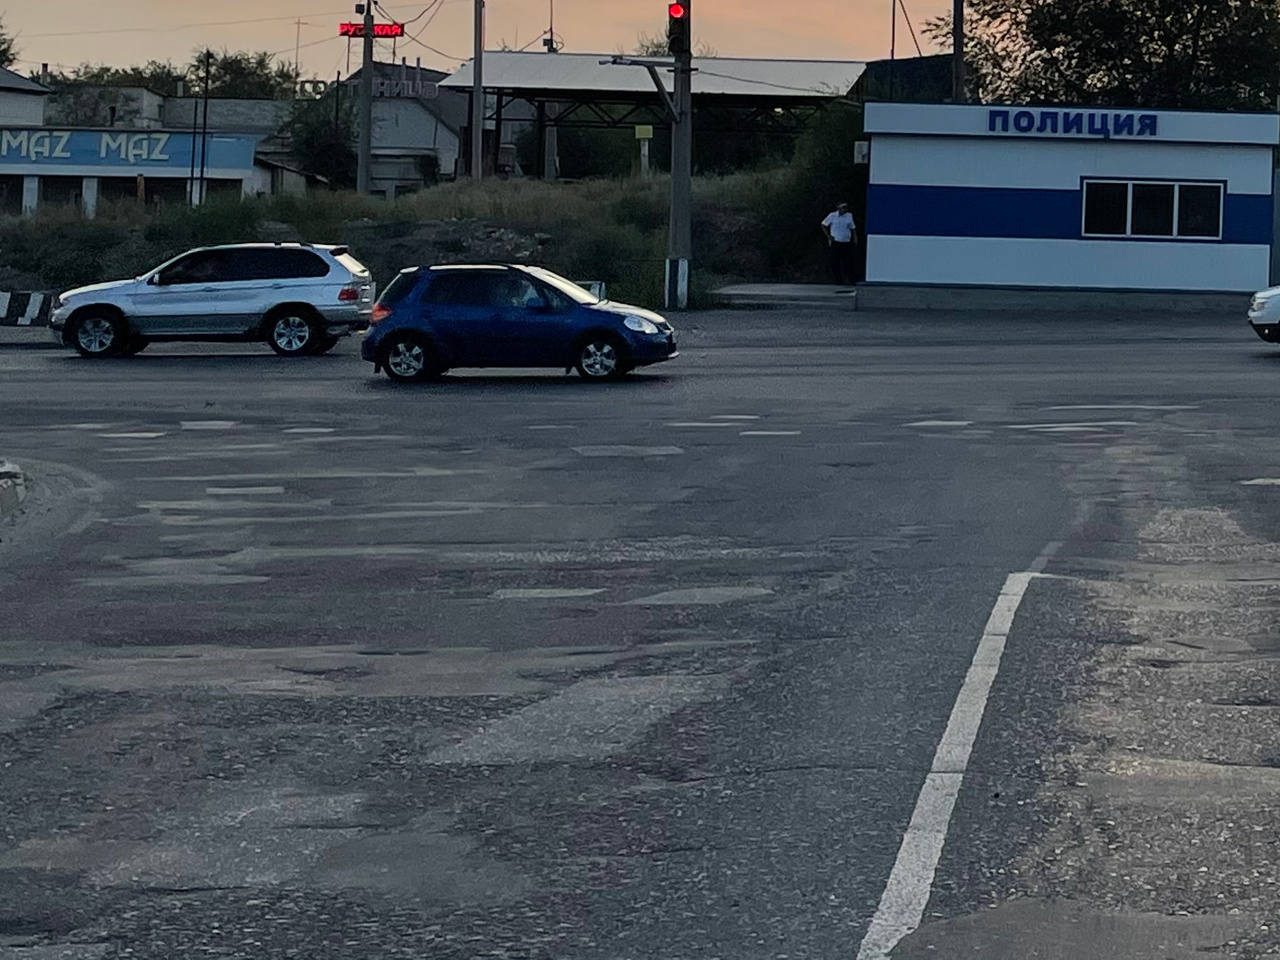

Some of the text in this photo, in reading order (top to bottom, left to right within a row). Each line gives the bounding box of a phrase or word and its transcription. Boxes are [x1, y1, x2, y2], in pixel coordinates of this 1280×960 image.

[339, 24, 402, 36] РУСКАЯ
[988, 109, 1158, 139] ПОЛИЦИЯ
[1, 129, 171, 165] MAZ MAZ
